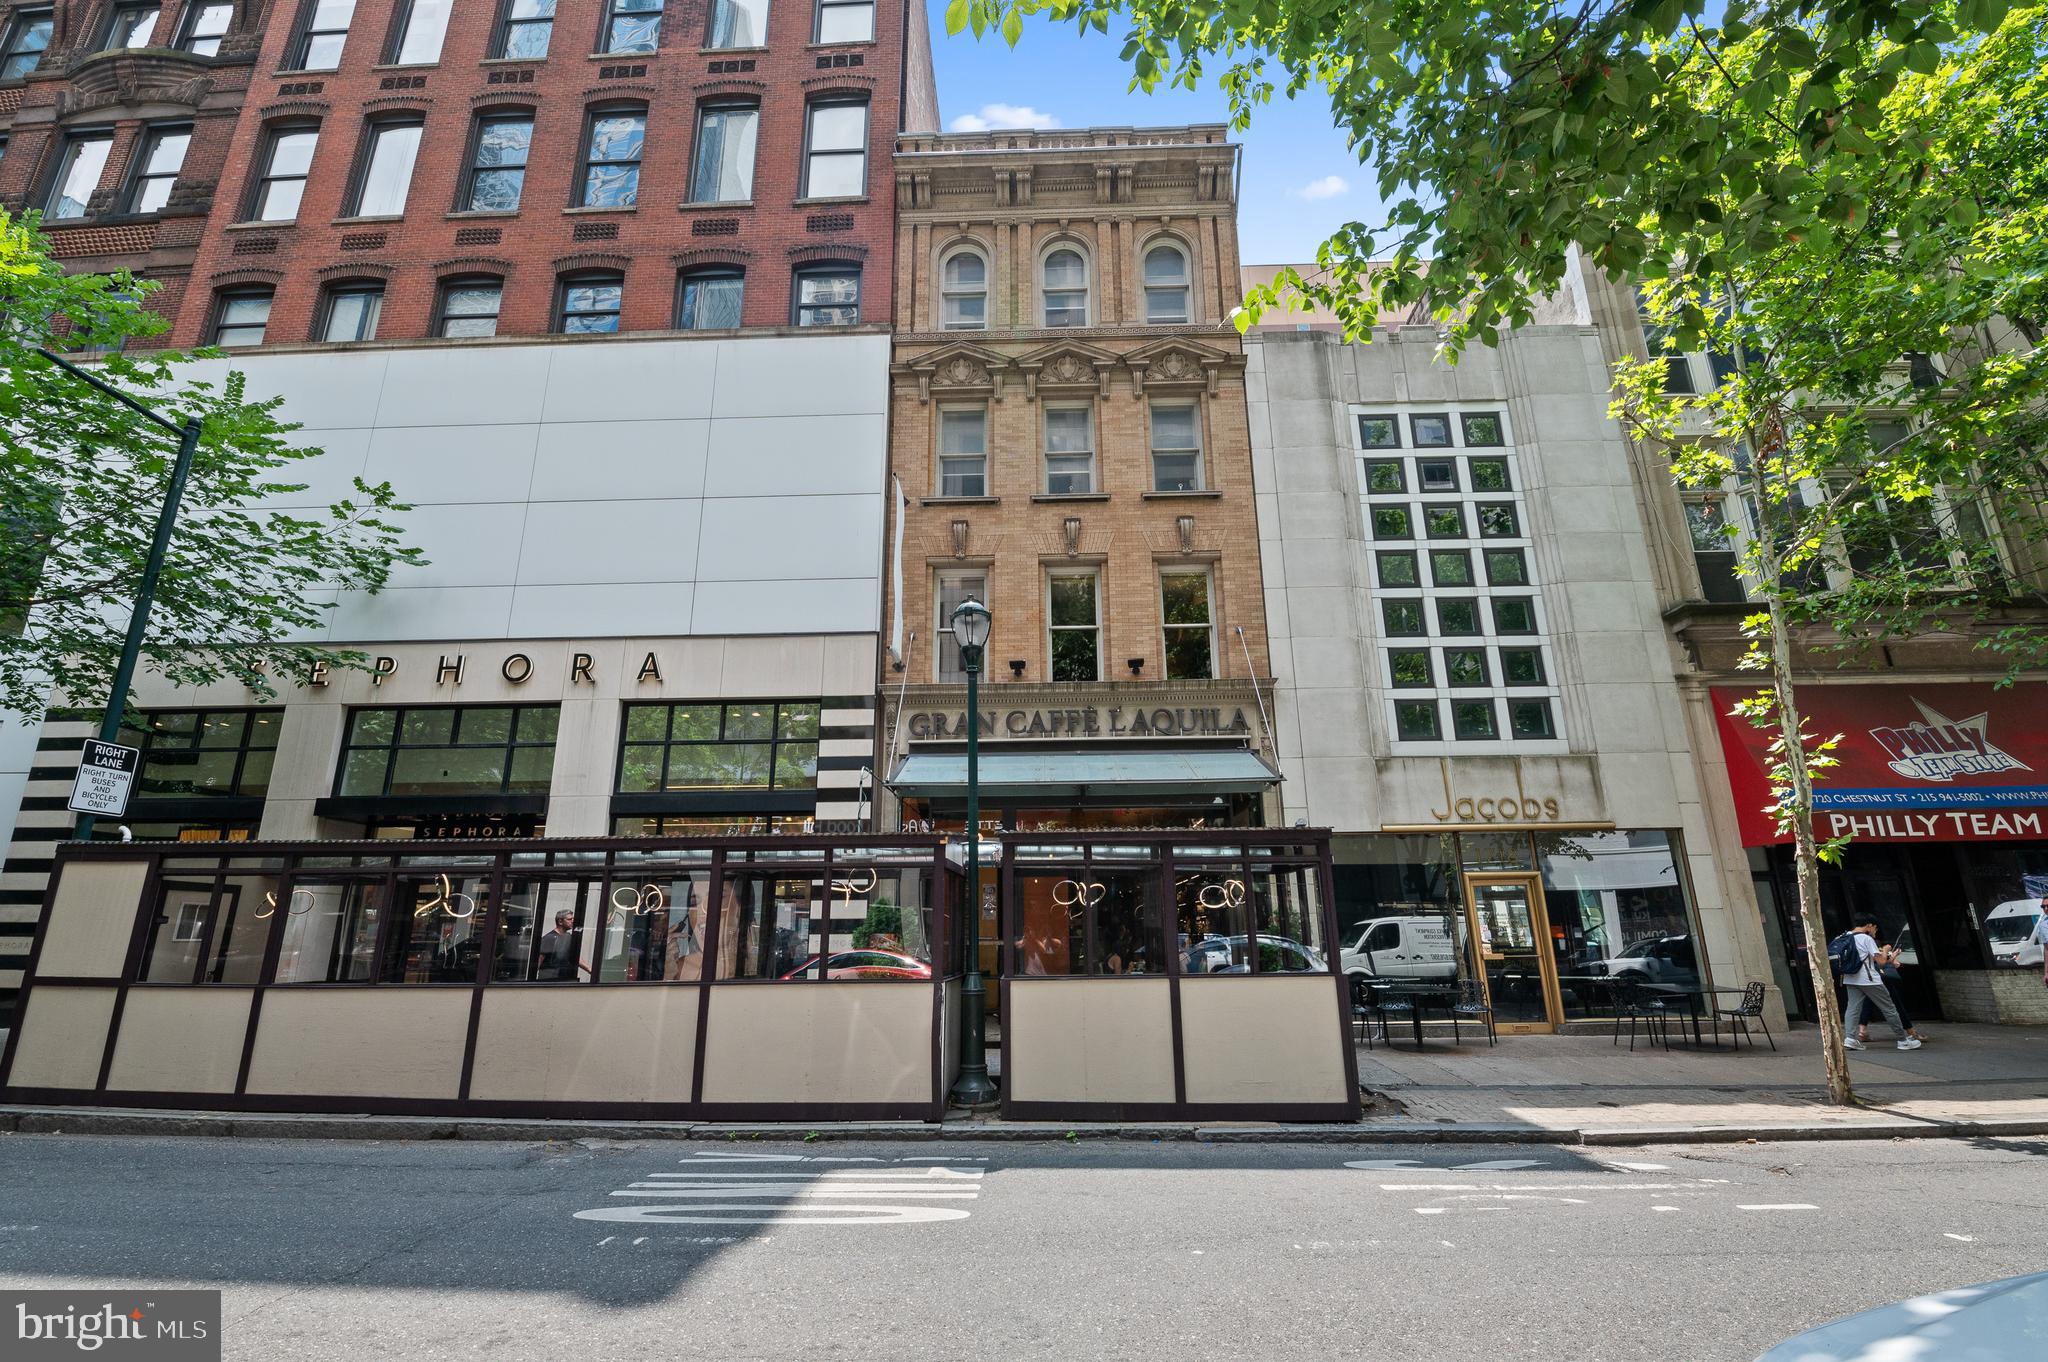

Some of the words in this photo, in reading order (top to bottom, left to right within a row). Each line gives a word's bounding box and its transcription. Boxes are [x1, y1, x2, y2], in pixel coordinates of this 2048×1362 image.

[908, 711, 997, 737] GRAN
[1871, 725, 1986, 761] PHILLY
[95, 744, 128, 759] RIGHT
[94, 756, 124, 769] LANE
[82, 767, 106, 778] RIGHT
[108, 772, 129, 782] TURN
[91, 777, 117, 787] BUSES
[1431, 757, 1560, 820] Jacobs
[93, 785, 111, 794] AND
[81, 791, 118, 803] BICYCLES
[1812, 794, 1832, 804] 720
[1833, 794, 1891, 804] CHESTNUT
[1894, 794, 1908, 803] ST
[1917, 793, 1937, 802] 215
[1939, 792, 1985, 802] 941-5002
[87, 799, 109, 809] ONLY
[1829, 813, 1940, 837] PHILLY
[1945, 811, 2042, 836] TEAM
[423, 826, 522, 838] SEPHORA
